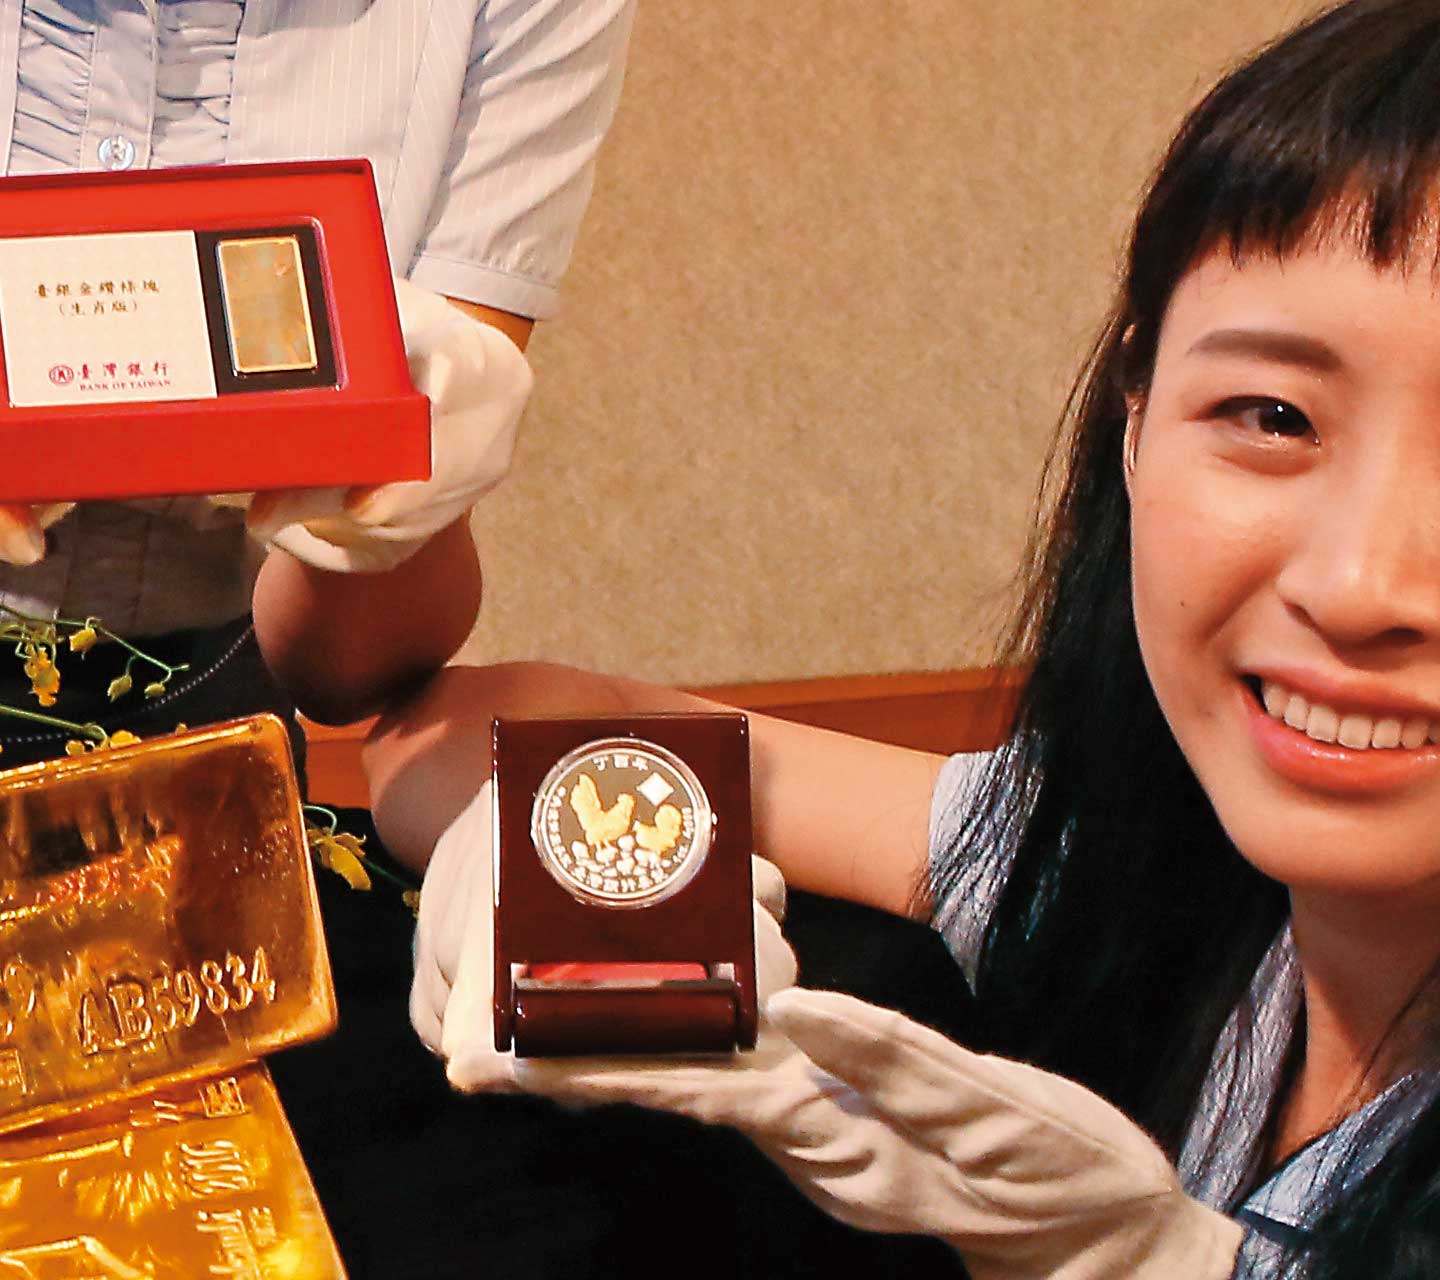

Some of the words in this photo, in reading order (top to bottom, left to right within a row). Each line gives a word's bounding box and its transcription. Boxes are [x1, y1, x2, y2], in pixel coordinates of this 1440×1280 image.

[78, 359, 169, 380] 臺灣銀行
[80, 381, 109, 392] BANK
[112, 380, 126, 390] OF
[130, 378, 171, 390] TAIWAN
[77, 946, 276, 1056] AB59834
